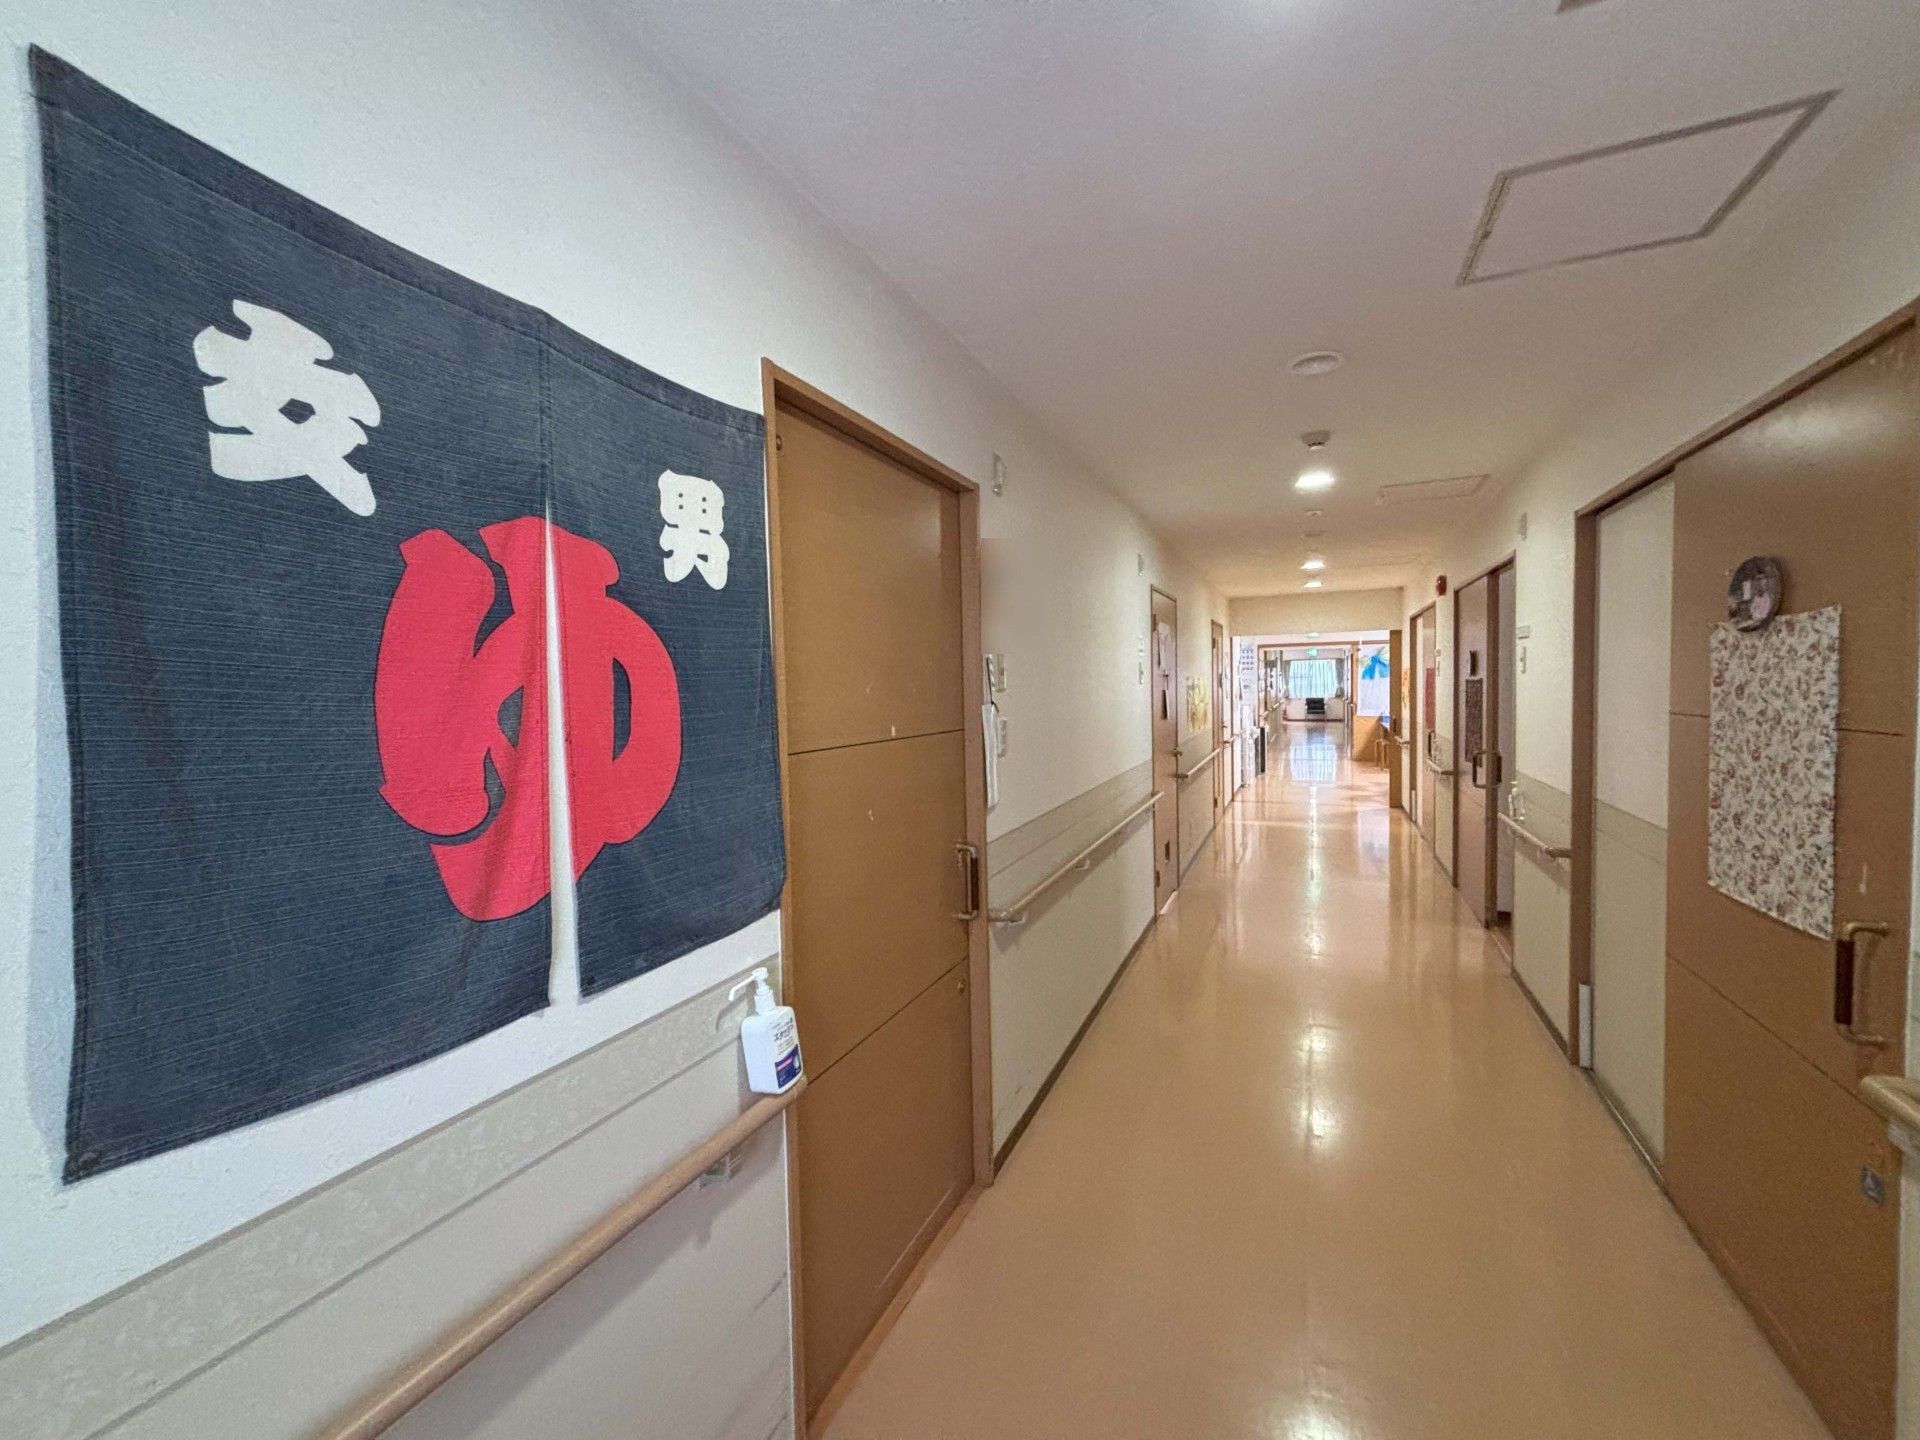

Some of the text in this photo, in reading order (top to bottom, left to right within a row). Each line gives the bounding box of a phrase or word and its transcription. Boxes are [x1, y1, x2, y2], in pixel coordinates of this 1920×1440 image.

[192, 298, 382, 518] 女
[657, 468, 730, 591] 男
[374, 515, 682, 921] ゆ
